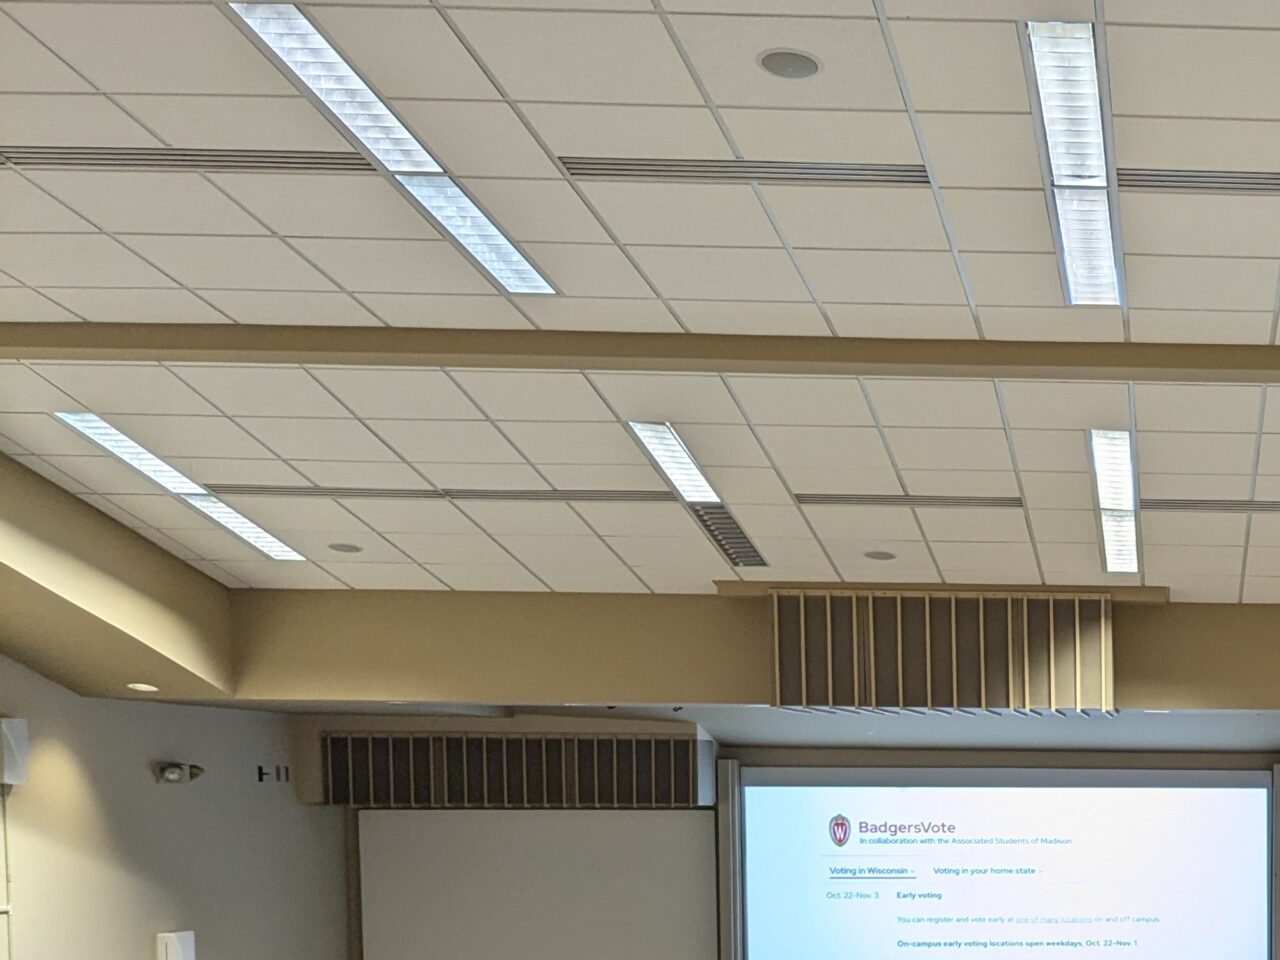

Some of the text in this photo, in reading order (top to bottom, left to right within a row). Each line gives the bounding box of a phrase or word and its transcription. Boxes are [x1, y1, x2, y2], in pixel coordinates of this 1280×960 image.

[859, 821, 956, 836] BadgersVote
[868, 837, 918, 845] collaboration
[920, 837, 936, 845] with
[937, 837, 949, 845] the
[951, 837, 994, 845] Associated
[995, 837, 1029, 845] Students
[1031, 837, 1039, 845] of
[1040, 837, 1073, 845] Madison
[829, 867, 909, 876] Voting in Wisconsin
[933, 867, 1036, 876] Voting in your home state
[826, 891, 841, 899] Oct.
[873, 891, 880, 899] 3
[896, 891, 943, 900] Early voting
[896, 916, 911, 924] You
[926, 916, 953, 925] register
[955, 916, 969, 924] and
[970, 916, 987, 924] vote
[988, 916, 1005, 925] early
[1105, 916, 1118, 924] and
[897, 940, 942, 948] On-campus
[943, 940, 962, 948] early
[963, 939, 988, 948] voting
[989, 939, 1023, 947] locations
[1025, 941, 1044, 949] open
[1046, 939, 1084, 948] weekdays,
[1086, 939, 1101, 947] Oct.
